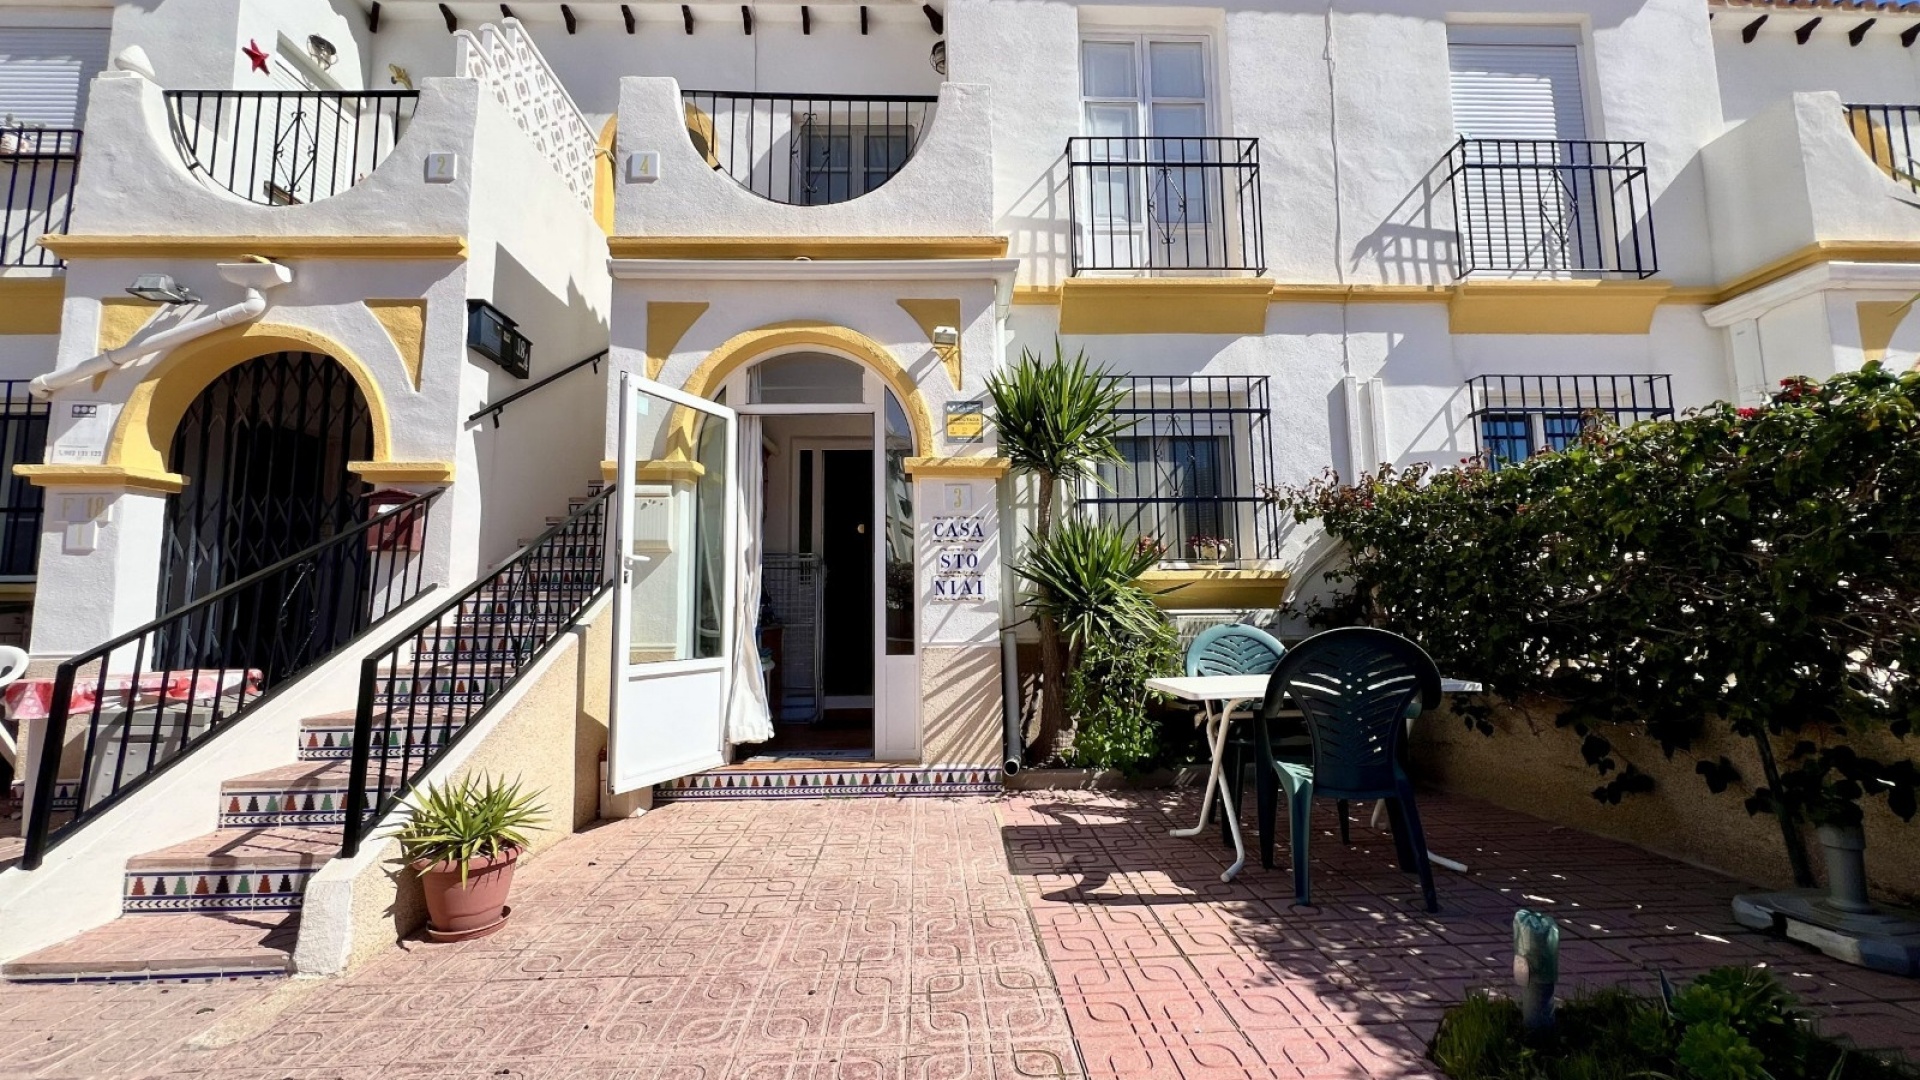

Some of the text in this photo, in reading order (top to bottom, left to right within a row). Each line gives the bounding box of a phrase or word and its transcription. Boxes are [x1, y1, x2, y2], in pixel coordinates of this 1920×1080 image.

[437, 156, 445, 174] 2
[640, 155, 649, 175] 4
[953, 488, 962, 508] 3
[934, 522, 984, 537] CASA
[941, 553, 979, 569] STO
[934, 580, 983, 595] NIAI
